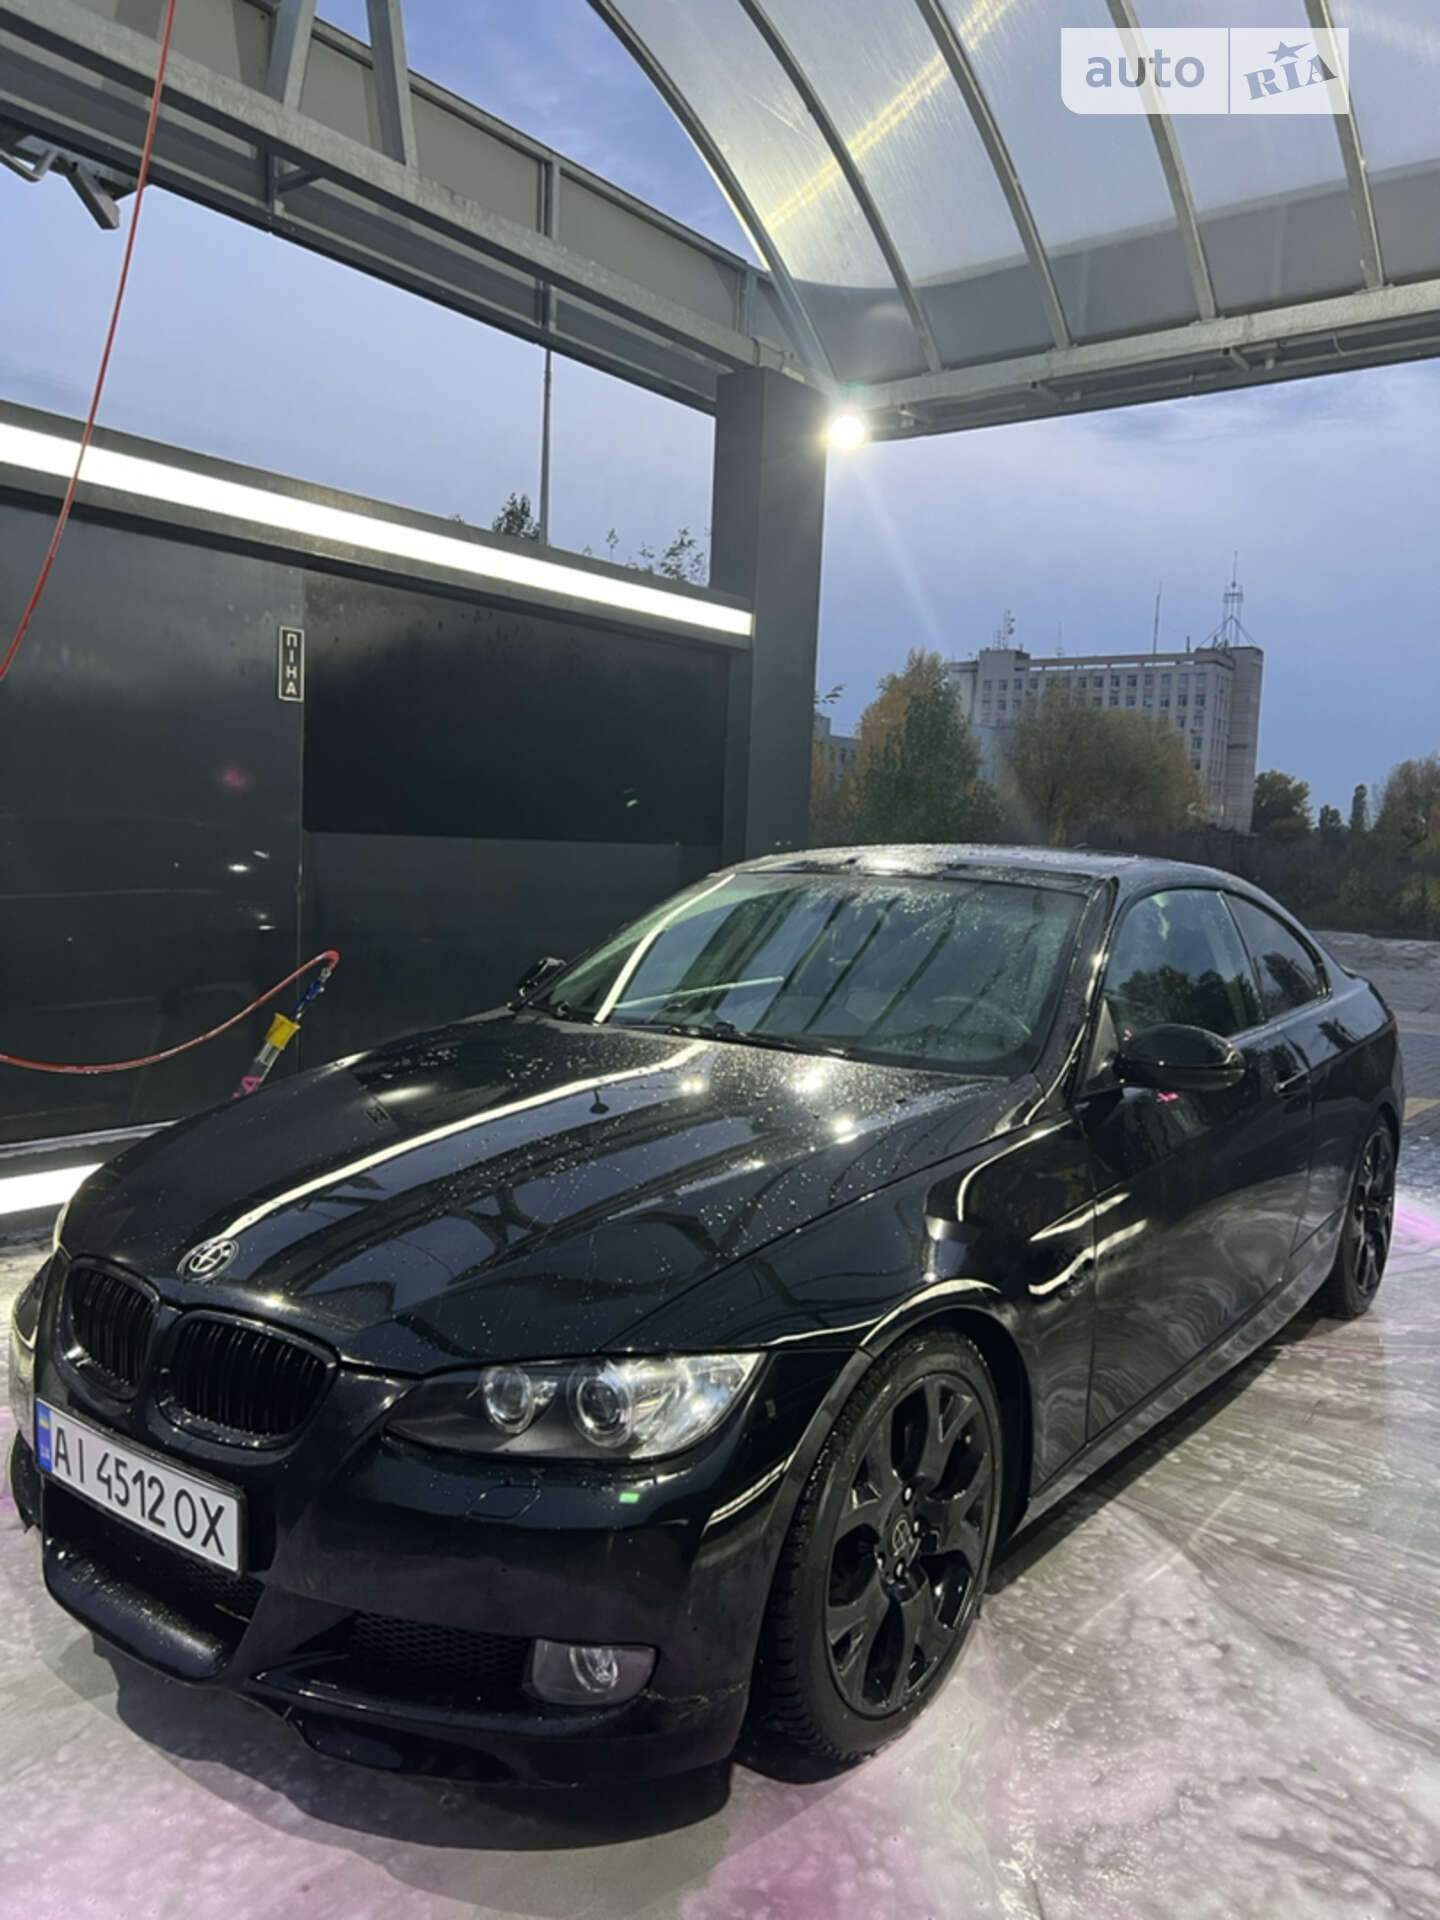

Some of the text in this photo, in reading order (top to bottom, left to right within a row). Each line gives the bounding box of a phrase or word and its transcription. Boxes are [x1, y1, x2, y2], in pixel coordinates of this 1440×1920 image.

[286, 633, 298, 695] ПІНА
[54, 1427, 225, 1557] AI 4512 OX
